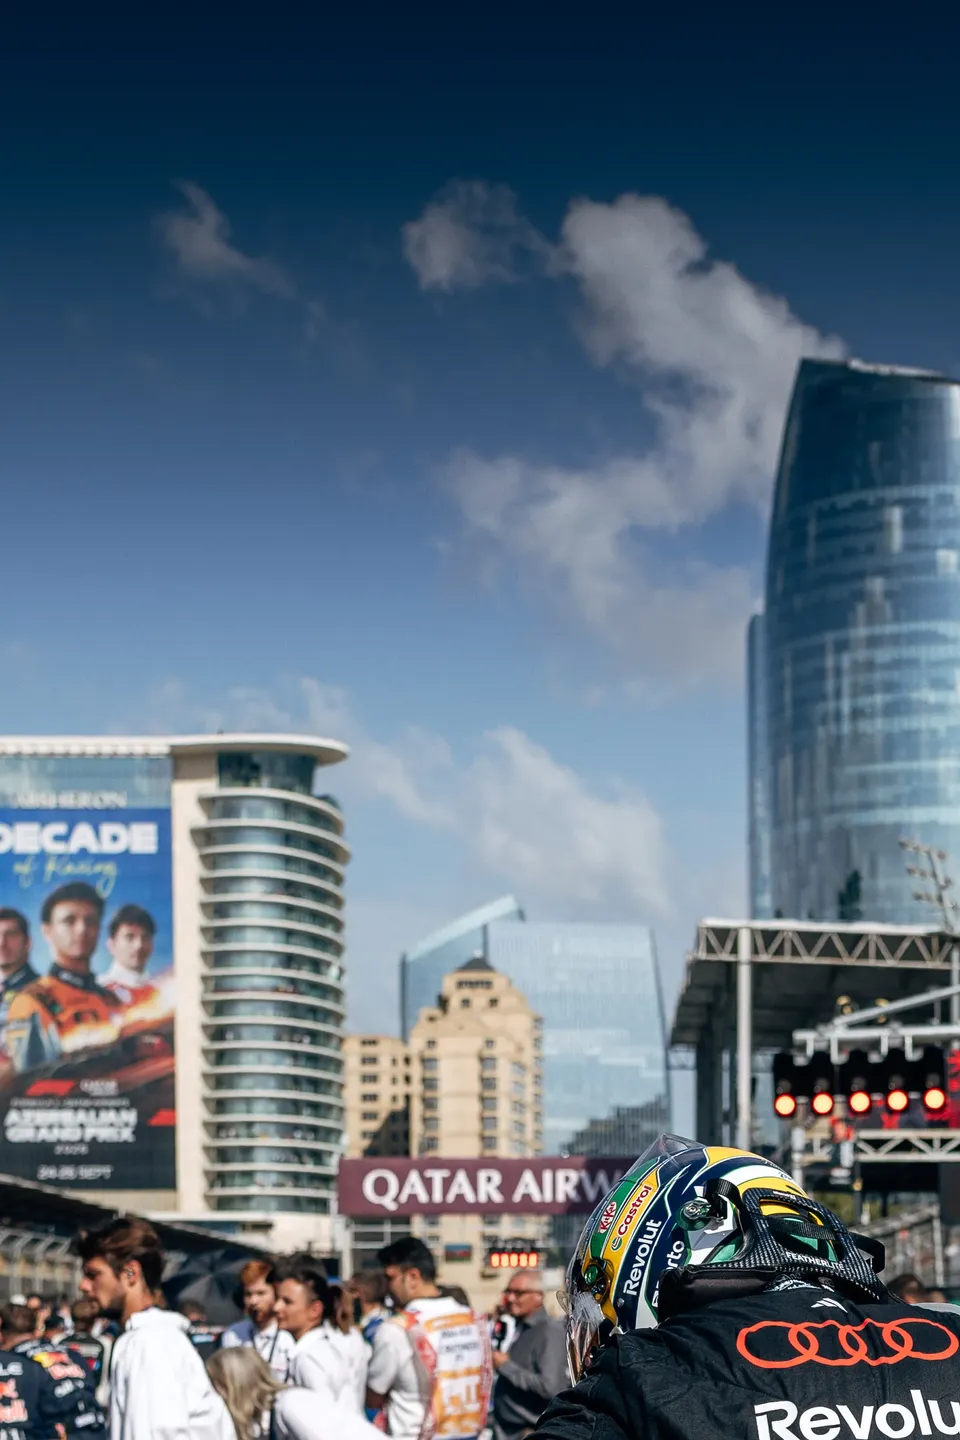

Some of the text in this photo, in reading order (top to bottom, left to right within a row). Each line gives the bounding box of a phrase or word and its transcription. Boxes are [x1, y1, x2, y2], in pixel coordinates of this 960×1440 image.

[362, 1168, 504, 1211] QATAR
[618, 1185, 652, 1236] Castrol
[600, 1202, 617, 1232] KitKat
[623, 1219, 662, 1296] Revolut
[785, 1250, 846, 1271] FEATHERLITE
